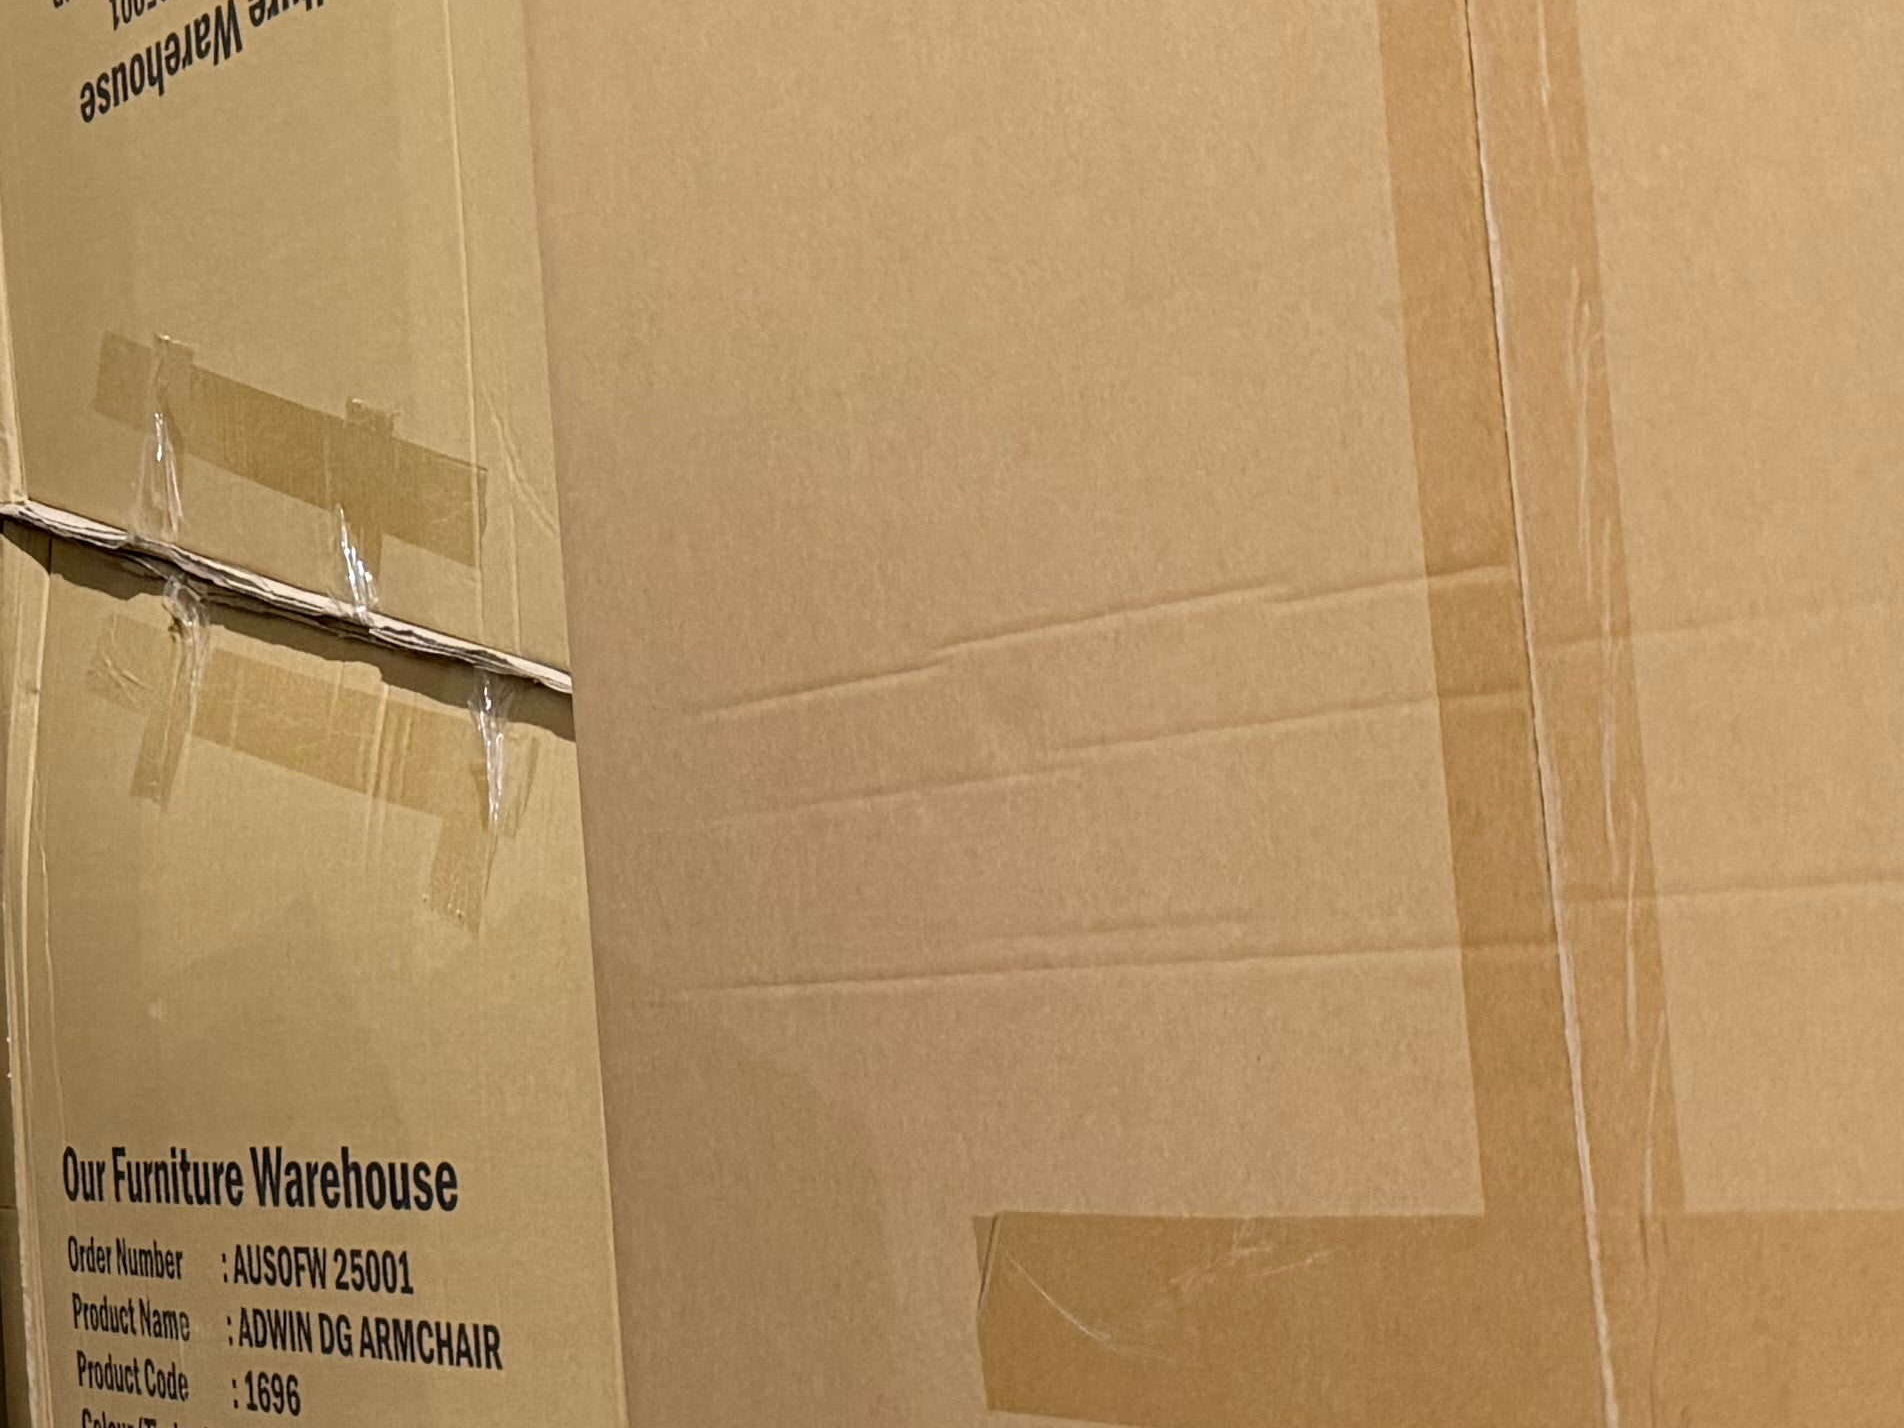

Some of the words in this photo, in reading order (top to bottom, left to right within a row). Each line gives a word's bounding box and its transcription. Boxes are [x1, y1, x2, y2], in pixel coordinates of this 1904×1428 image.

[62, 1146, 106, 1202] Our
[111, 1146, 244, 1207] Furniture
[249, 1146, 458, 1212] Warehouse
[67, 1235, 112, 1275] Order
[115, 1237, 183, 1280] Number
[233, 1244, 327, 1290] AUSOFW
[333, 1247, 414, 1295] 25001
[71, 1292, 137, 1336] Product
[138, 1295, 190, 1342] Name
[238, 1306, 313, 1354] ADWIN
[317, 1312, 354, 1357] DG
[359, 1315, 503, 1370] ARMCHAIR
[76, 1350, 143, 1396] Product
[144, 1358, 189, 1402] Code
[245, 1370, 301, 1417] 1696
